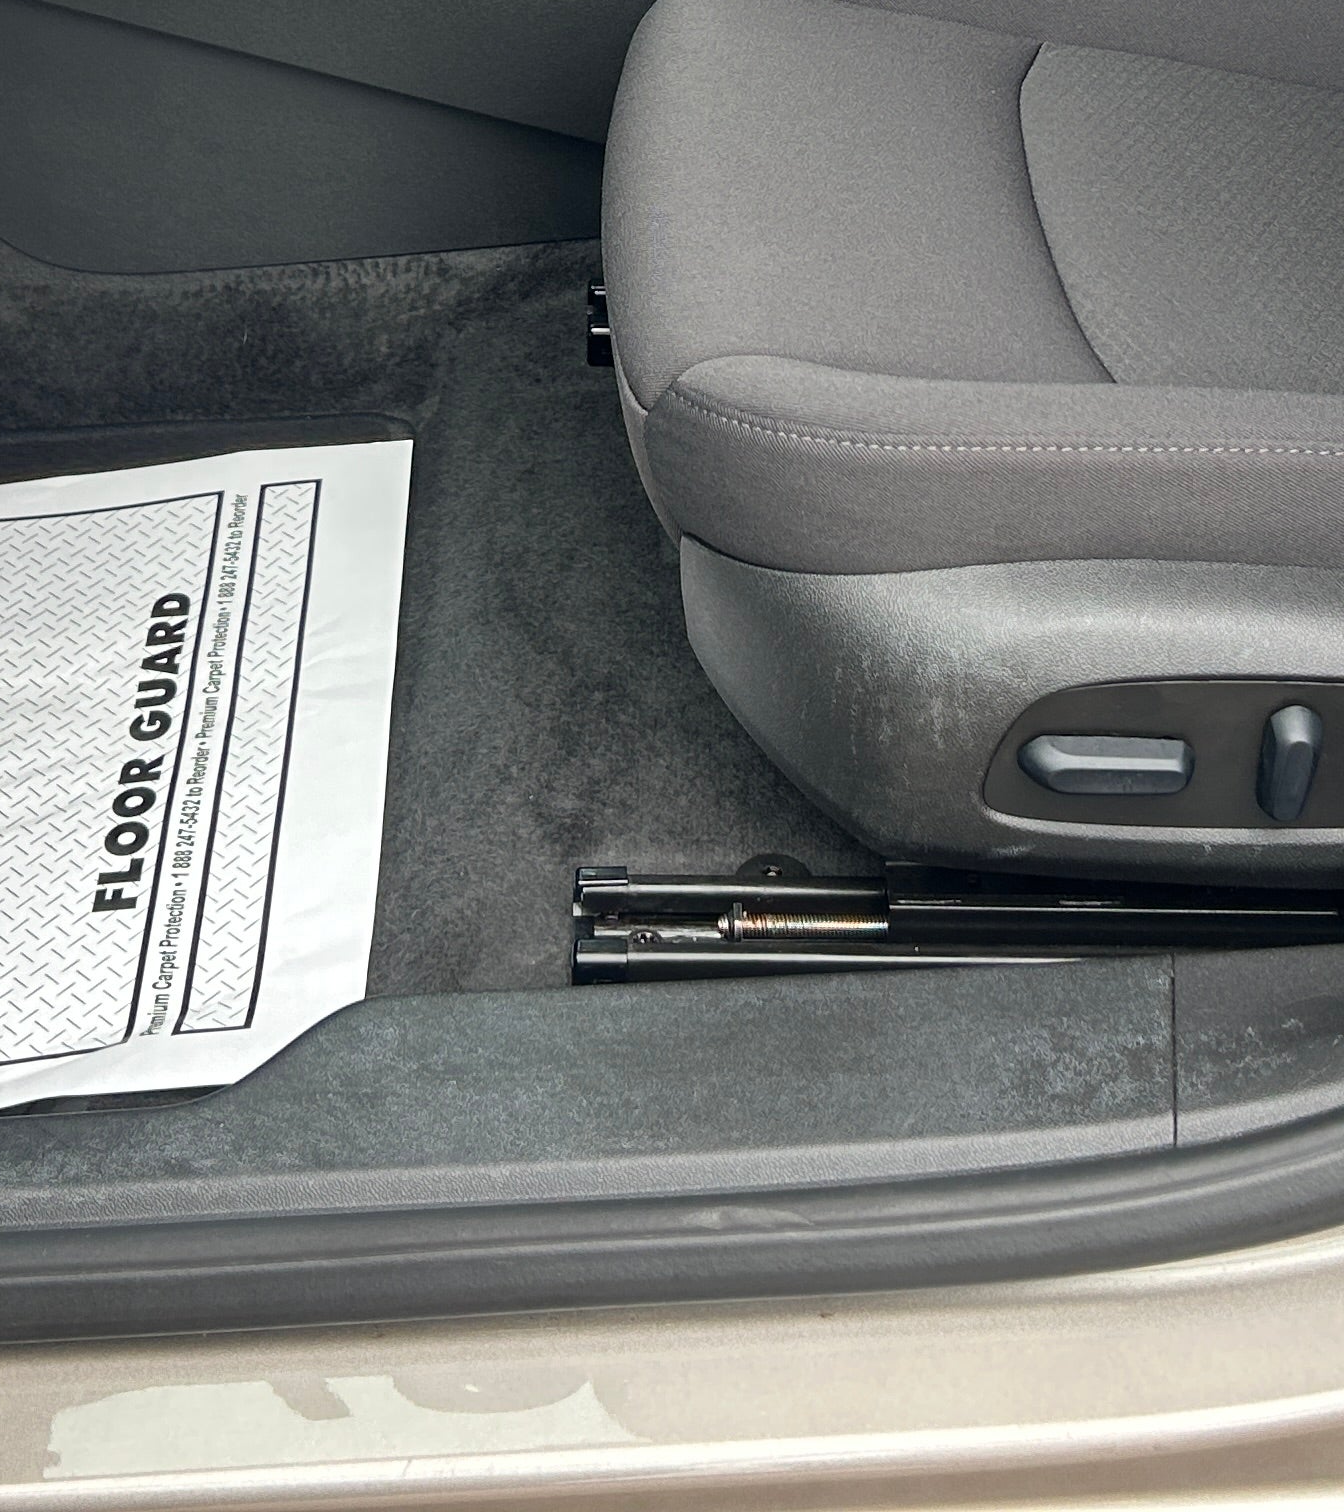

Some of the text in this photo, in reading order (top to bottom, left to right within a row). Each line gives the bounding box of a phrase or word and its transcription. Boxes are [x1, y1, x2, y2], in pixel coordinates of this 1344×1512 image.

[227, 494, 248, 528] Reorder
[227, 530, 243, 539] to
[220, 541, 242, 580] 247-5432
[217, 582, 236, 597] 888
[207, 611, 231, 657] Protection
[202, 660, 226, 693] Carpet
[195, 696, 219, 738] Premium
[92, 592, 191, 912] FLOOR GUARD
[186, 748, 210, 785] Reorder
[185, 787, 203, 797] to
[176, 799, 201, 847] 247-5432
[172, 850, 193, 869] 888
[159, 889, 187, 947] Protection
[152, 950, 180, 990] Carpet
